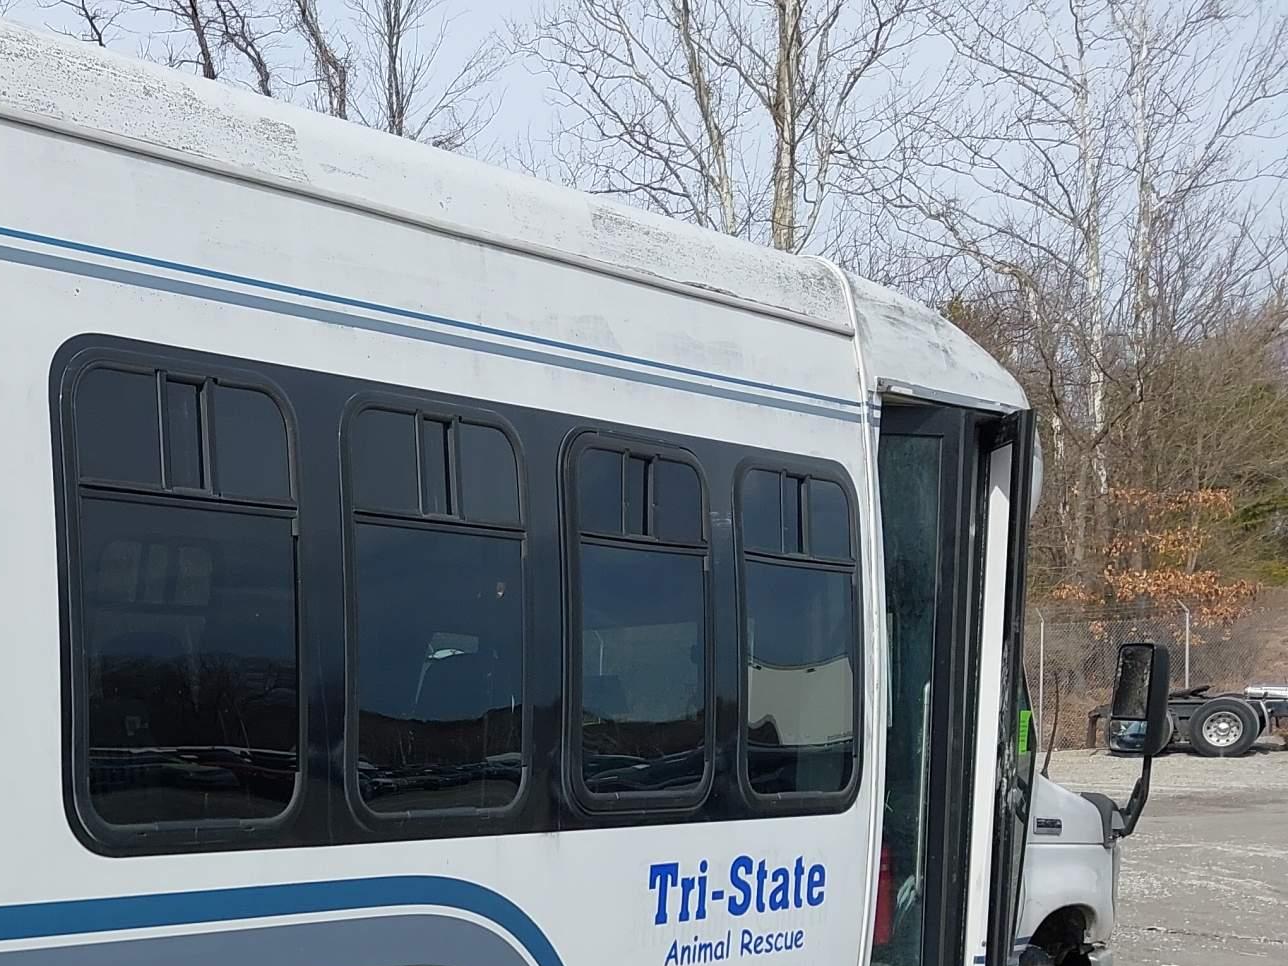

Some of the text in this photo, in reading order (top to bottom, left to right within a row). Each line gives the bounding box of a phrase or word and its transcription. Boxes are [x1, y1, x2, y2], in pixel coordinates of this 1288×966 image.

[648, 855, 826, 926] Tri-State
[664, 929, 804, 966] Animal Rescue
